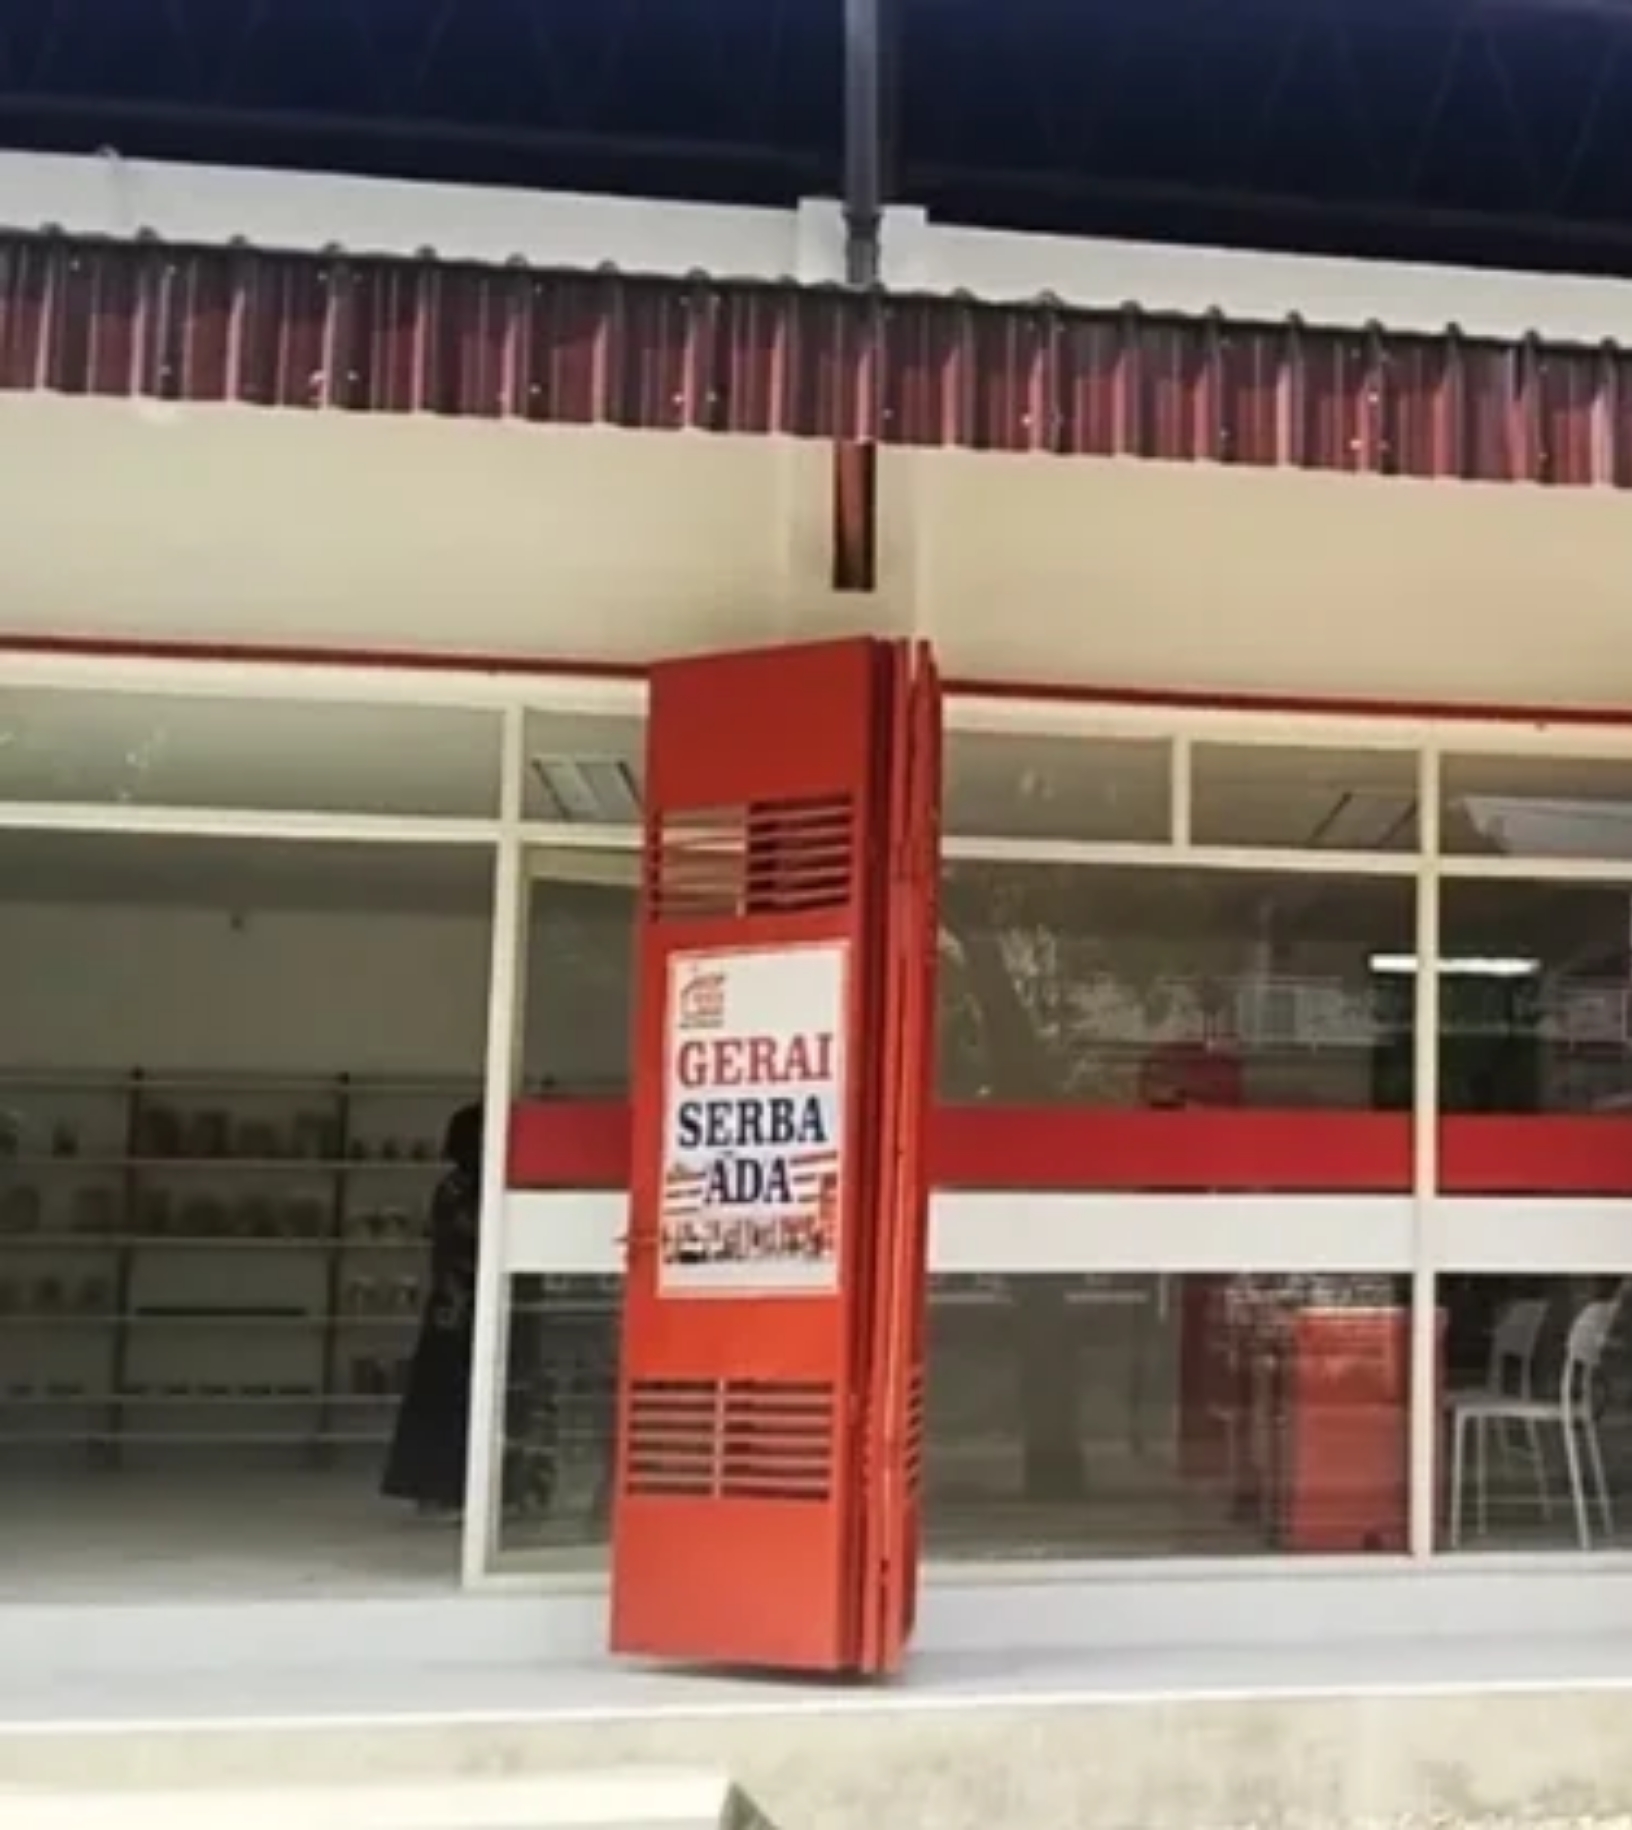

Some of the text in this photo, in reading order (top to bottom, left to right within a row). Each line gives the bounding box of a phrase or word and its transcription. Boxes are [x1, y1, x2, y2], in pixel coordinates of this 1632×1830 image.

[678, 1033, 832, 1088] GERAI
[678, 1095, 827, 1148] SERBA
[704, 1157, 793, 1205] ADA
